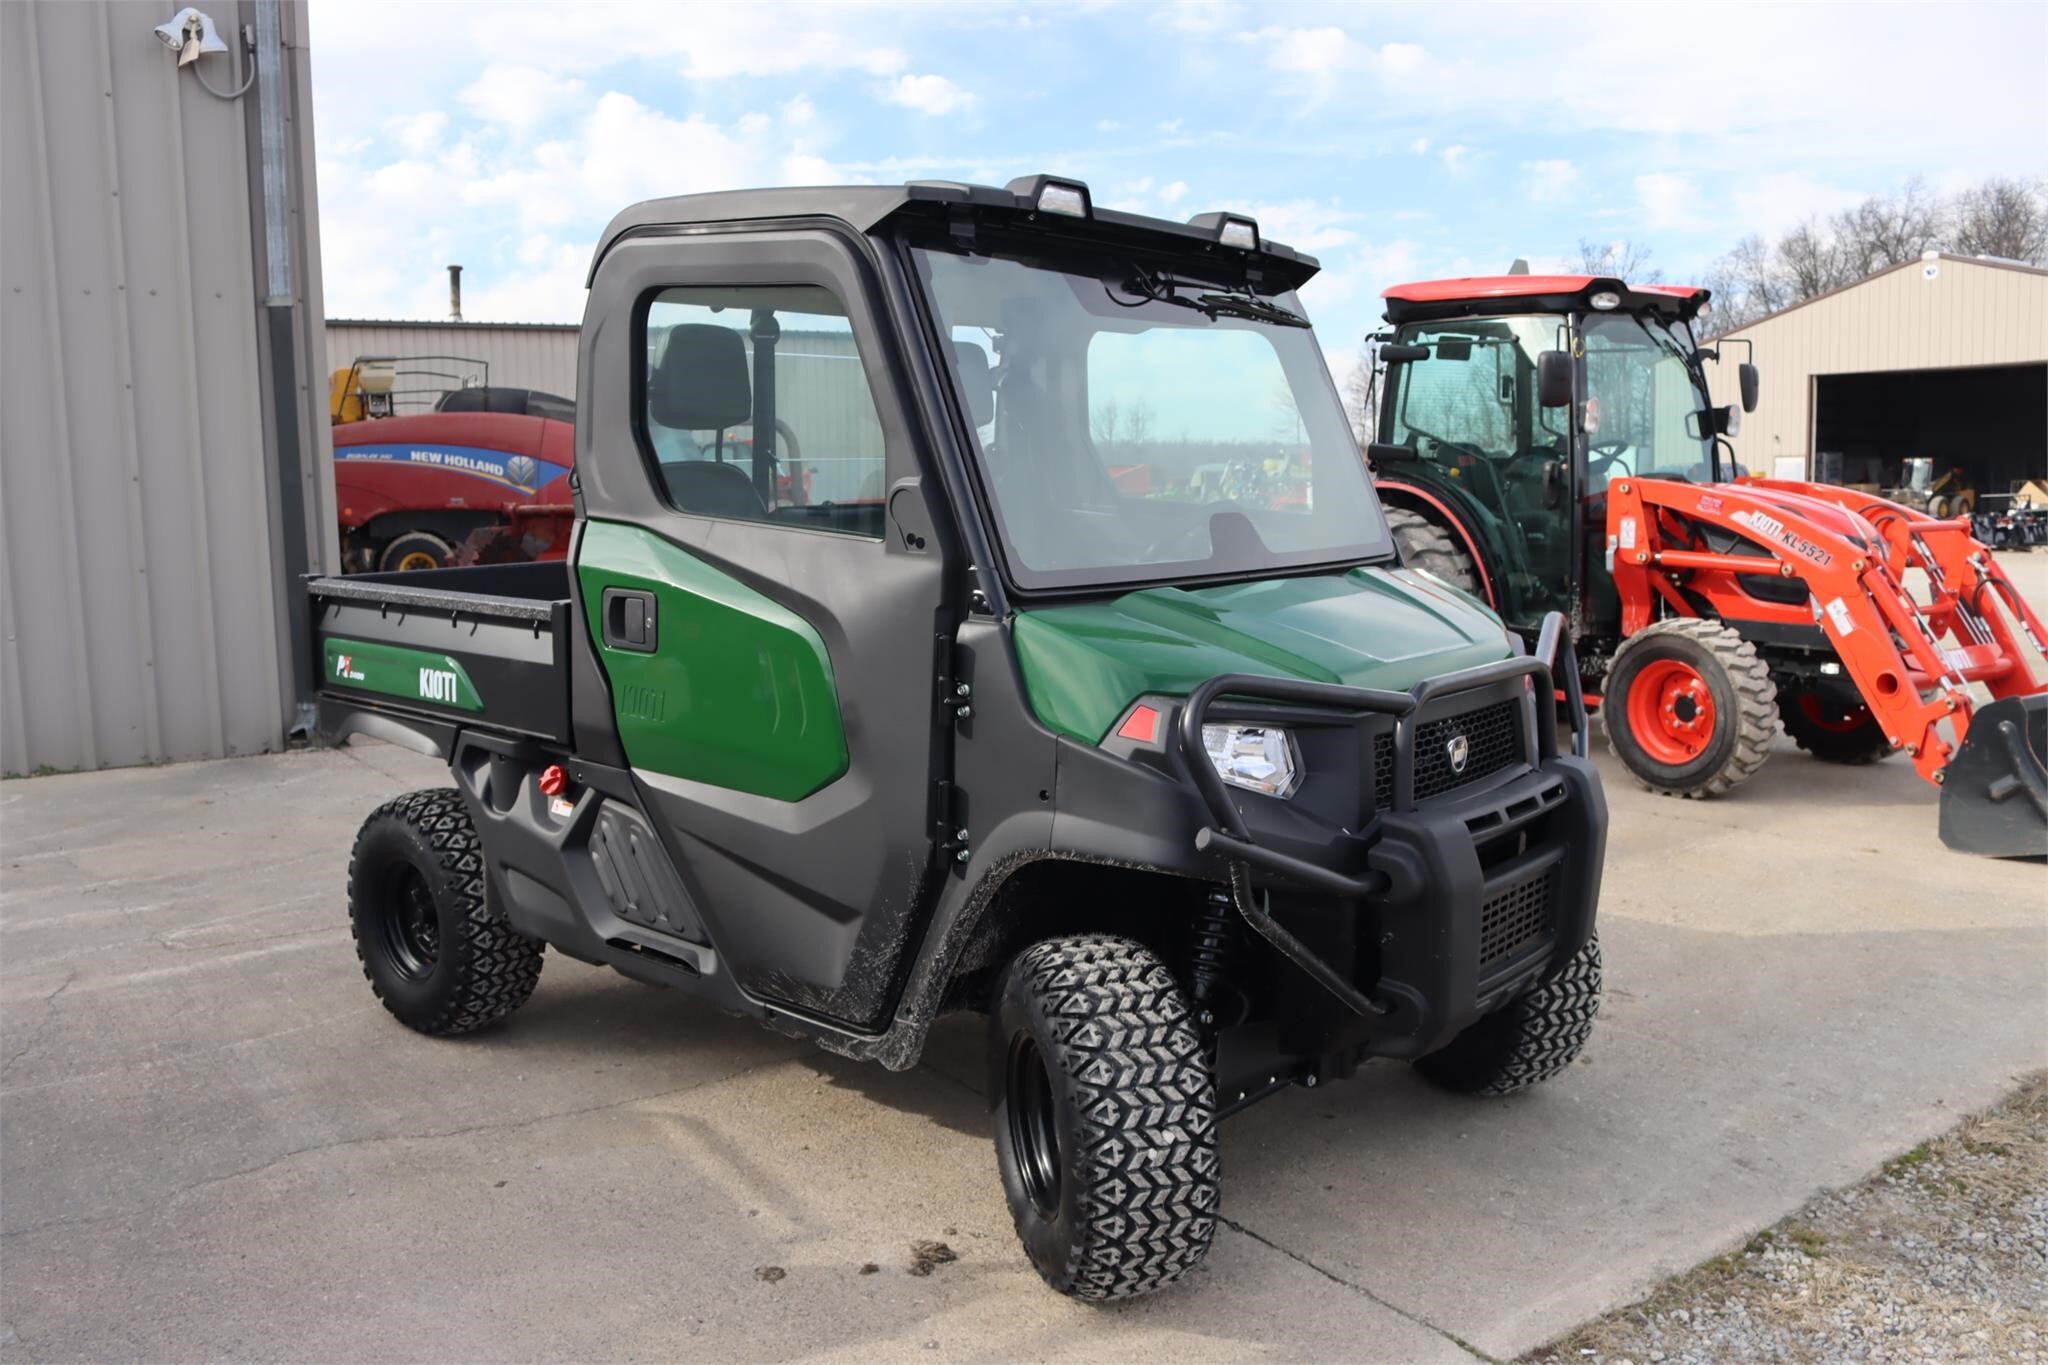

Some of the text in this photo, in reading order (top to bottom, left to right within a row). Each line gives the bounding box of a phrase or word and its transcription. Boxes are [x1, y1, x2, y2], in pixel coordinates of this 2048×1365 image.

[410, 450, 504, 476] NEW HOLLAND
[1747, 510, 1832, 566] KIOTI KL 5521
[420, 667, 457, 703] KIOTI
